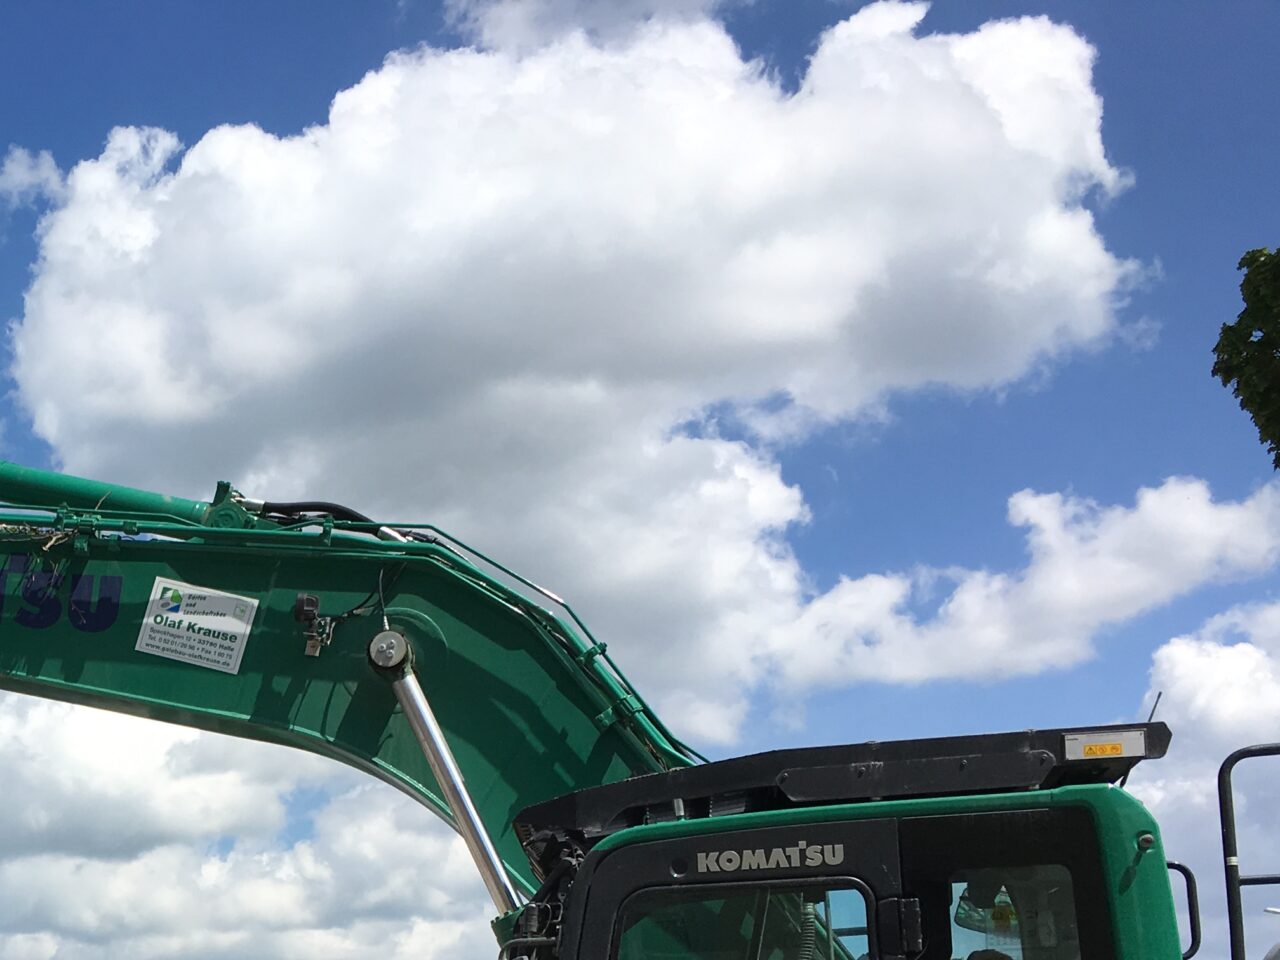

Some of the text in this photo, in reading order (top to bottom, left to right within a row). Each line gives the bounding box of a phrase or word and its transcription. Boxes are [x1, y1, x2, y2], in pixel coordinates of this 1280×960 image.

[153, 614, 238, 643] Olaf Krause
[218, 643, 235, 652] Halle
[697, 841, 845, 873] KOMATSU
